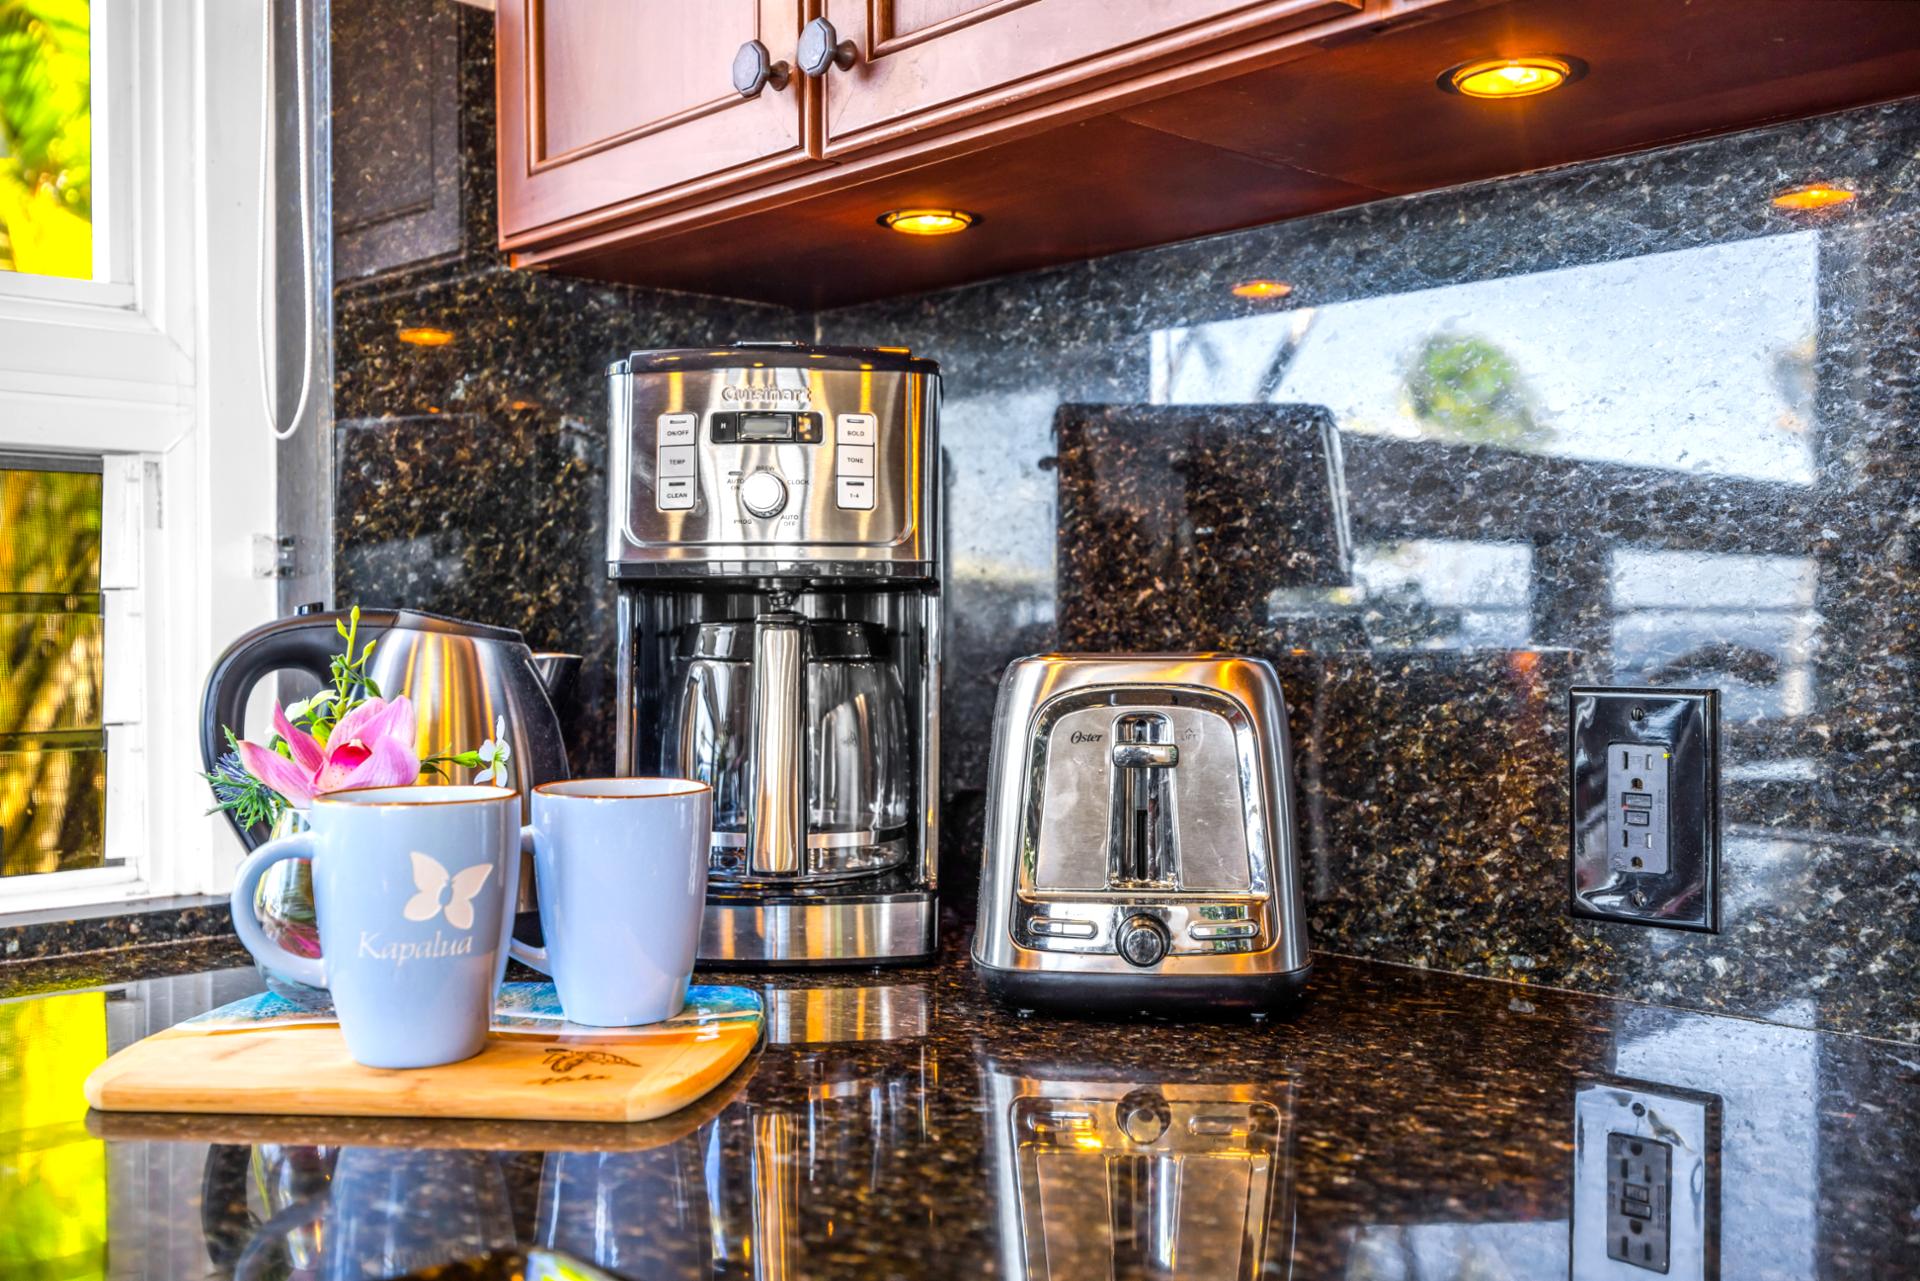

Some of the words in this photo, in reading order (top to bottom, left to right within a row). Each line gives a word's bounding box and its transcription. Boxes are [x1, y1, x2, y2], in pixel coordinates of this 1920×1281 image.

[722, 384, 811, 402] Cuisinart
[847, 456, 864, 464] TONE
[1070, 730, 1103, 744] Oster
[357, 928, 474, 967] Kapalua
